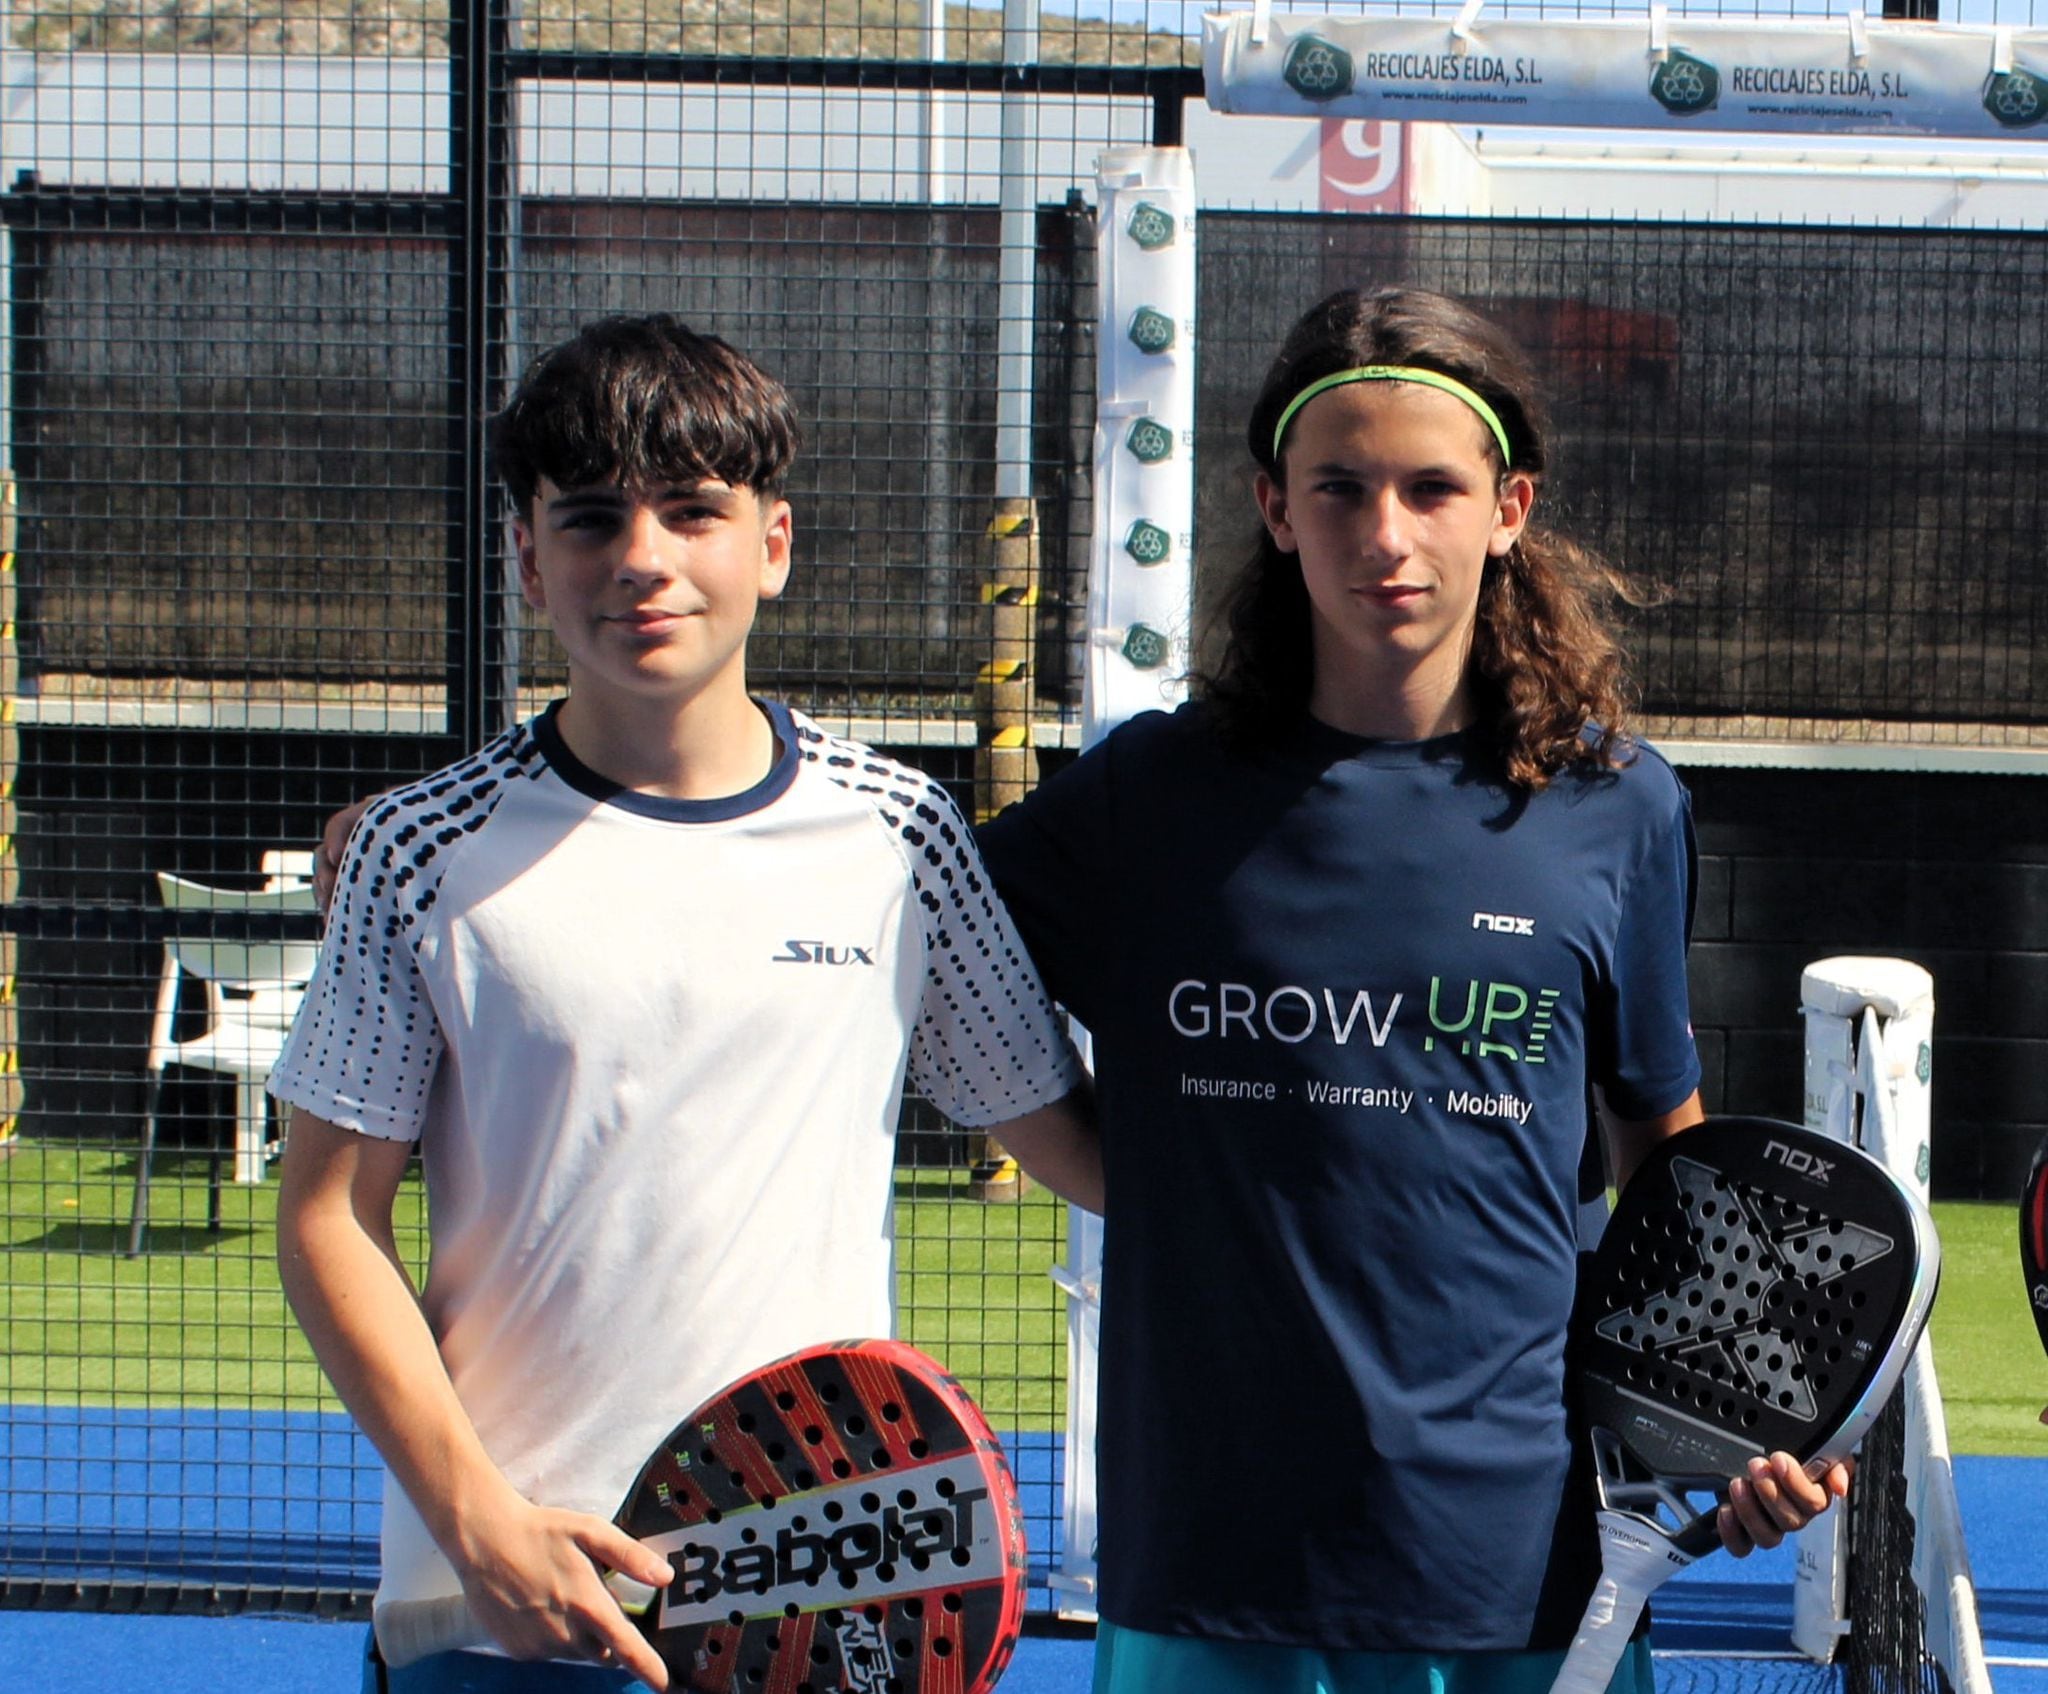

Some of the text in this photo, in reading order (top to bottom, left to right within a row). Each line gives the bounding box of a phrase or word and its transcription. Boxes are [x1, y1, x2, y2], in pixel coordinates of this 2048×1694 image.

[1367, 53, 1543, 87] RECICLAJES ELDA, S.L.
[1733, 67, 1908, 101] RECICLAJES ELDA, S.L.
[1382, 90, 1528, 104] www.reciclajeselda.com
[1748, 104, 1893, 118] www.reciclajeselda.com
[1168, 975, 1530, 1048] GROW UP
[1181, 1073, 1533, 1126] Insurance Warranty Mobility
